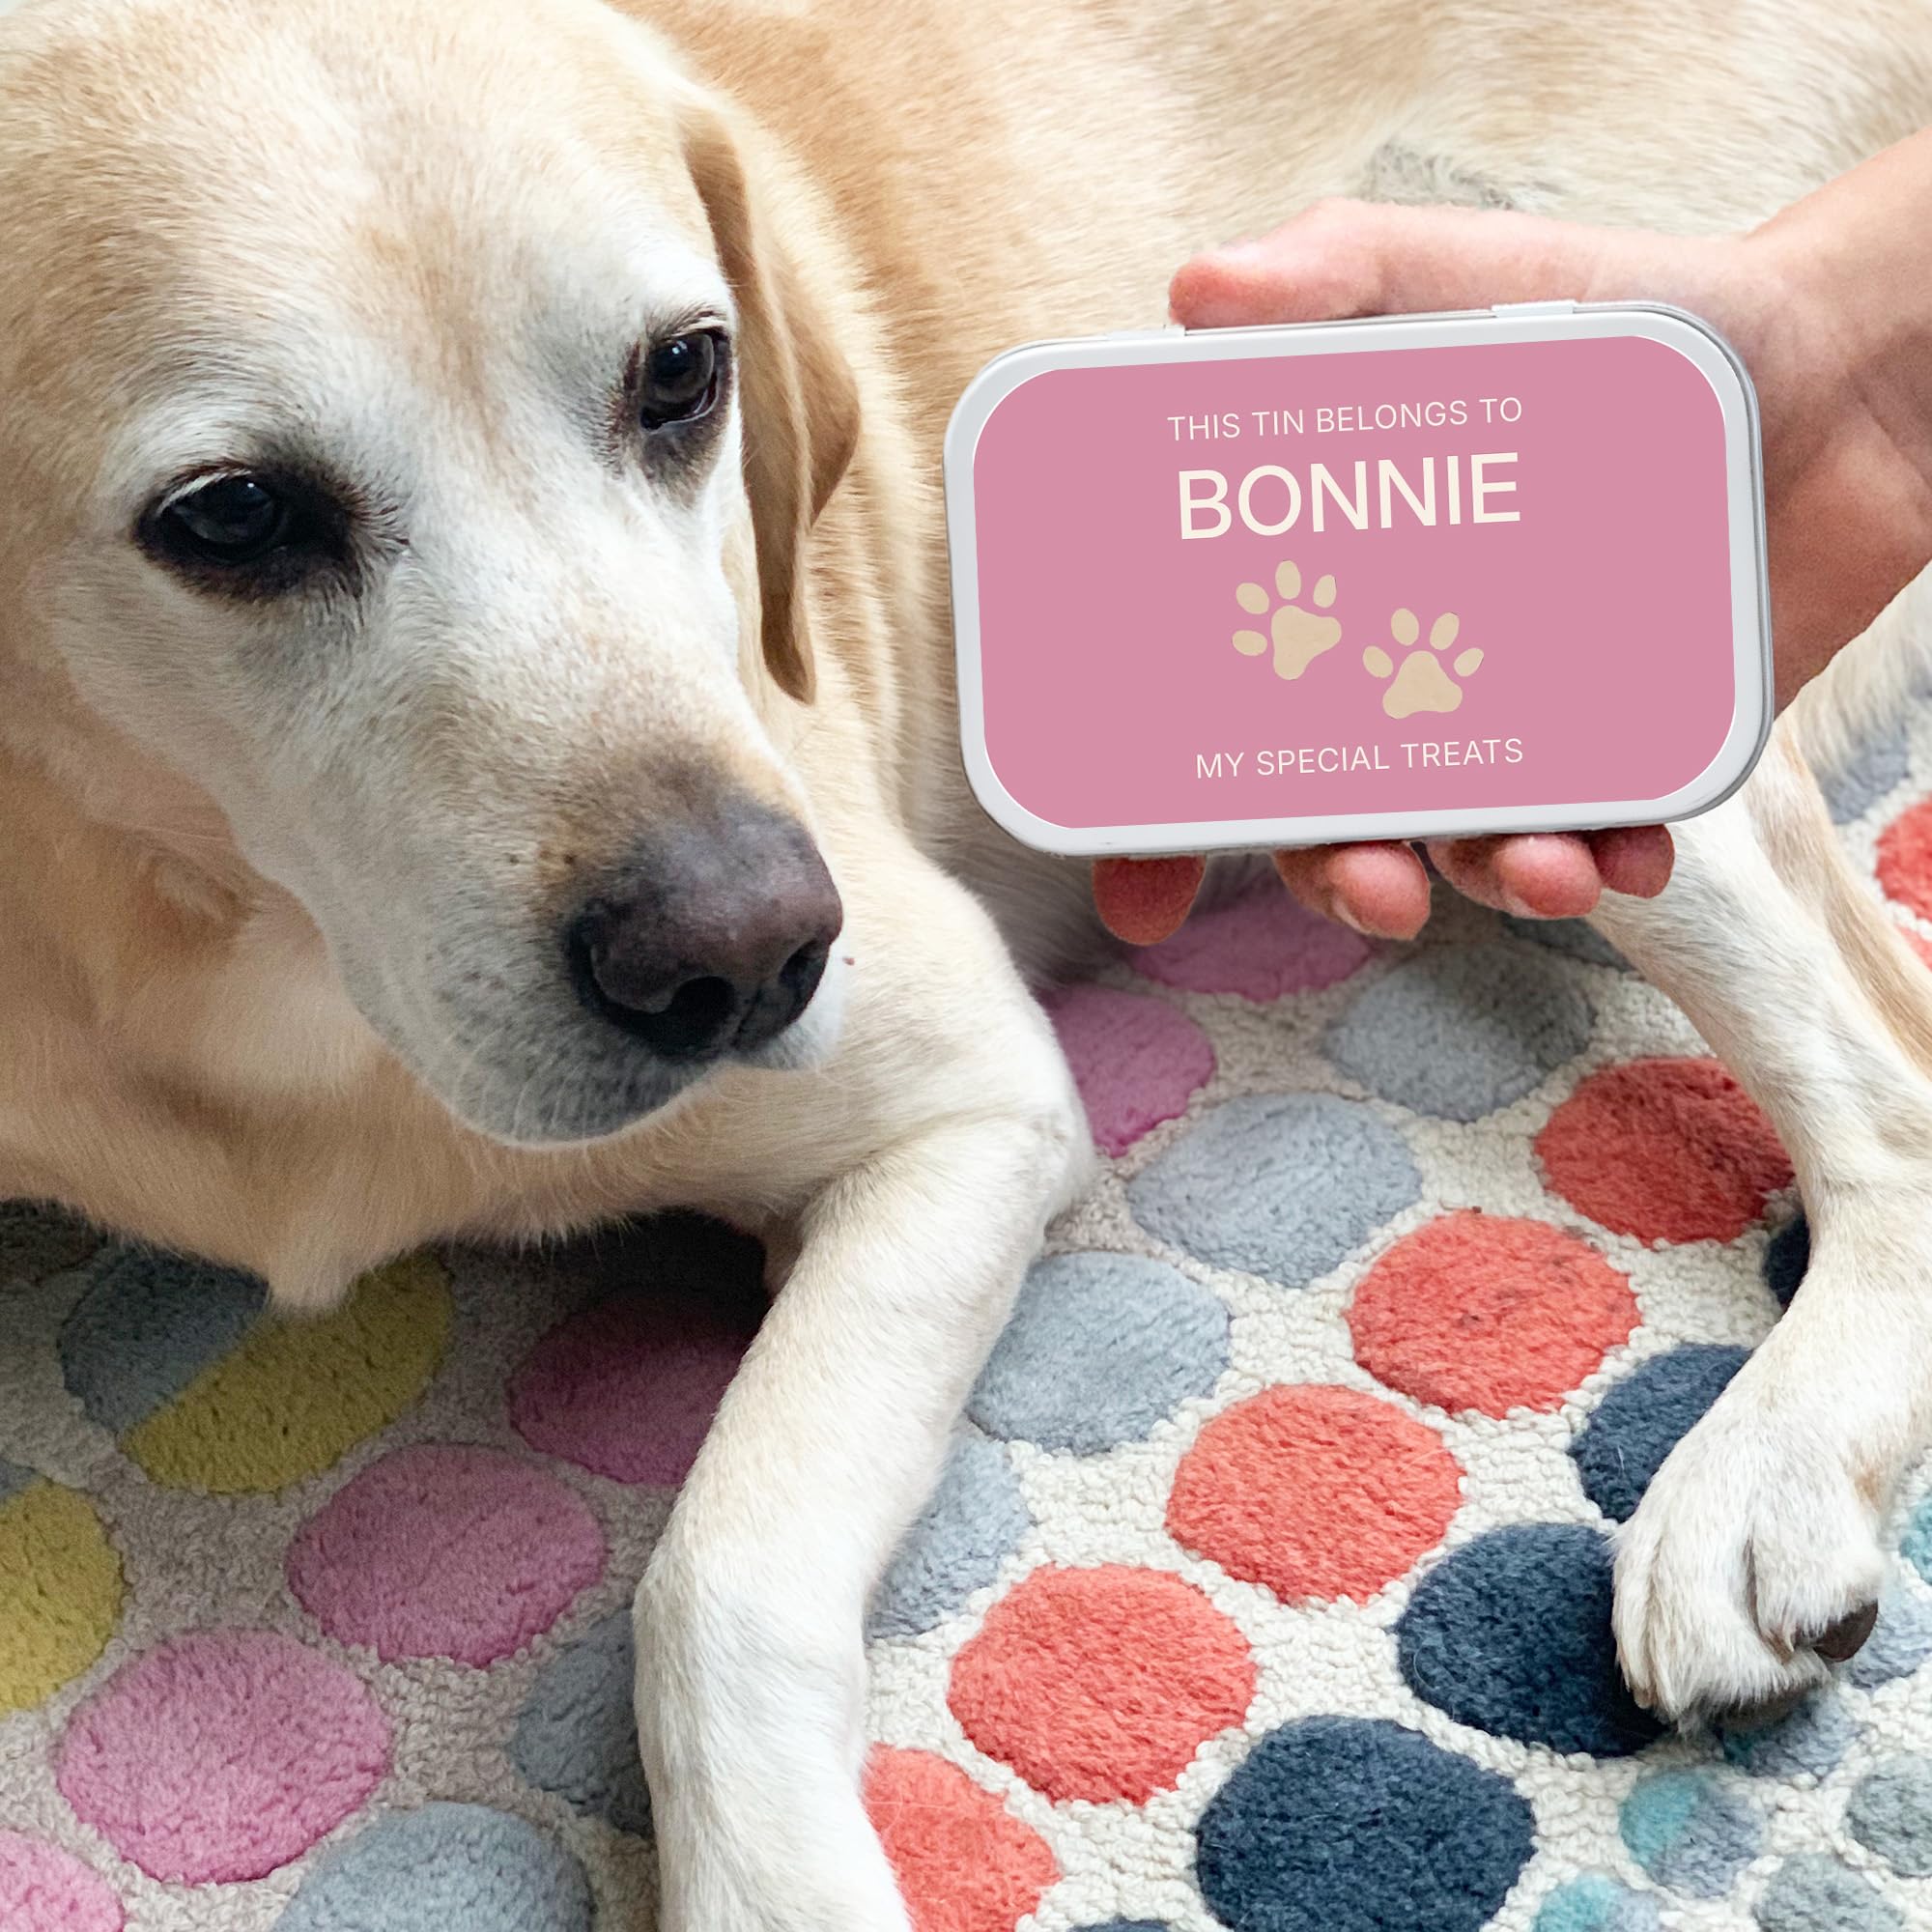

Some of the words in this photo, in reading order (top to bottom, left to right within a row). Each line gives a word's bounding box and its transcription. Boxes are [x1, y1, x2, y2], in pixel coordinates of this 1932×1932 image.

[1166, 411, 1240, 441] THIS
[1251, 409, 1304, 437] TIN
[1317, 400, 1468, 433] BELONGS
[1478, 396, 1522, 424] TO
[1179, 451, 1521, 540] BONNIE
[1196, 752, 1244, 779] MY
[1257, 745, 1390, 776] SPECIAL
[1400, 737, 1523, 768] TREATS
